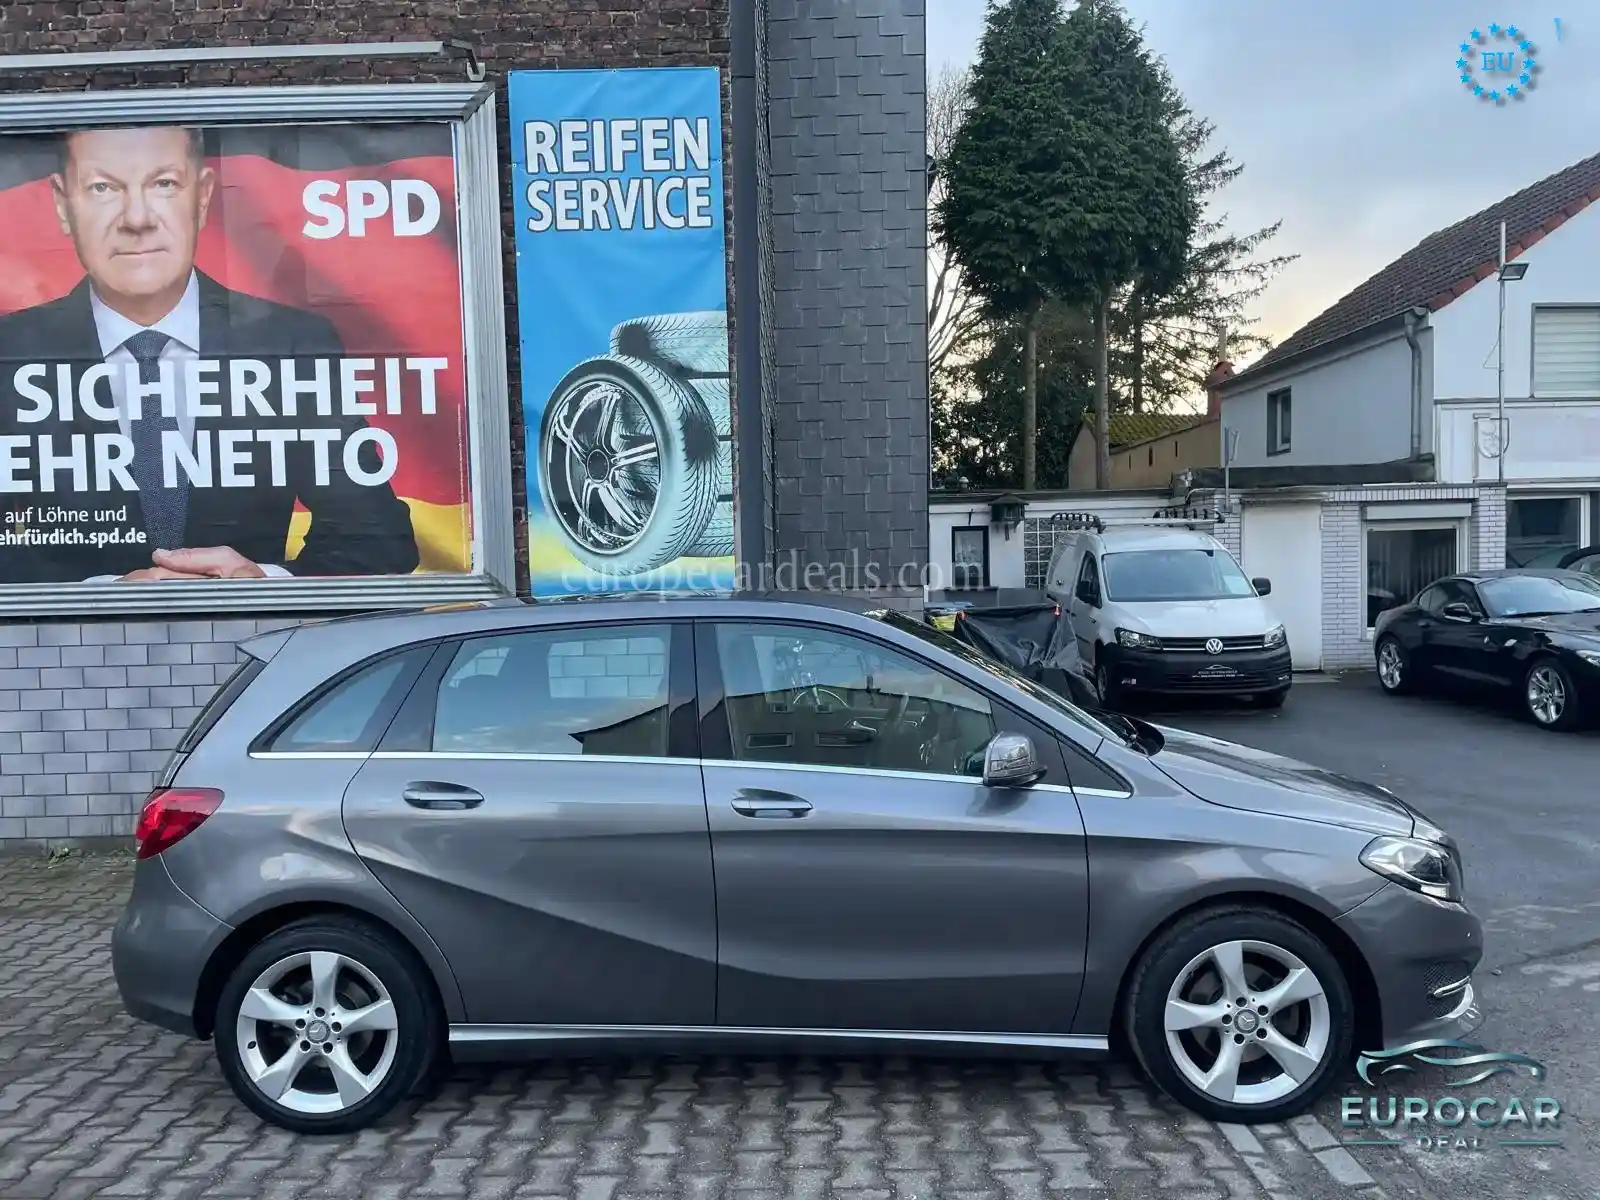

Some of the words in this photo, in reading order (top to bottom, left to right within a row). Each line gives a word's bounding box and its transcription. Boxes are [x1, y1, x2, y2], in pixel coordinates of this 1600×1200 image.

[524, 117, 709, 174] REIFEN
[302, 179, 440, 239] SPD
[526, 176, 713, 233] SERVICE
[14, 358, 447, 422] SICHERHEIT
[162, 428, 398, 488] NETTO
[5, 507, 33, 523] auf
[38, 507, 89, 523] Löhne
[94, 505, 127, 522] und
